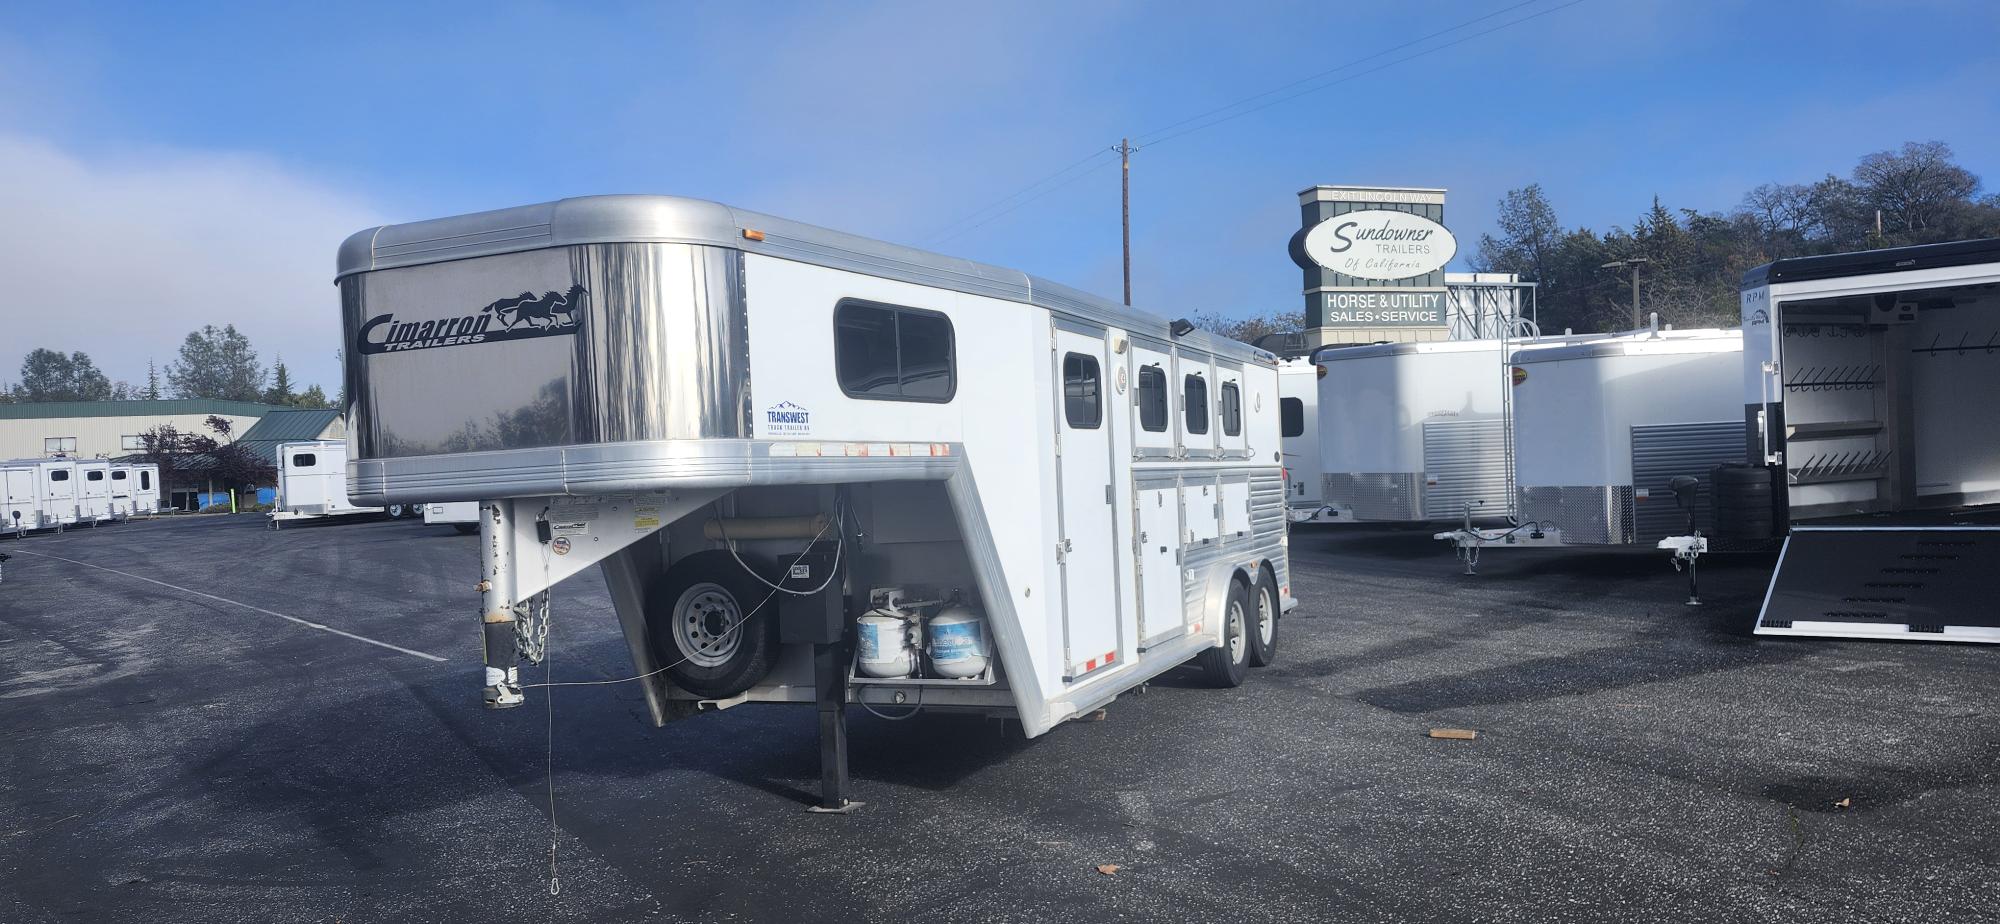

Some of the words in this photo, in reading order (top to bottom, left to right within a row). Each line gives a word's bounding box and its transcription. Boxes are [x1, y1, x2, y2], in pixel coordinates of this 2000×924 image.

[1331, 190, 1355, 200] EXIT
[1359, 191, 1407, 202] LINCOLN
[1410, 193, 1433, 203] WAY
[1330, 219, 1433, 253] Sundowner
[1376, 243, 1430, 254] TRAILERS
[1344, 258, 1360, 270] Of
[1365, 257, 1421, 271] California
[1327, 293, 1376, 309] HORSE
[1379, 294, 1389, 308] &
[1391, 294, 1439, 308] UTILITY
[1381, 311, 1438, 322] SERVICE
[357, 313, 492, 355] Cimarron
[384, 333, 486, 351] TRAILERS
[767, 411, 808, 423] TRANSWEST
